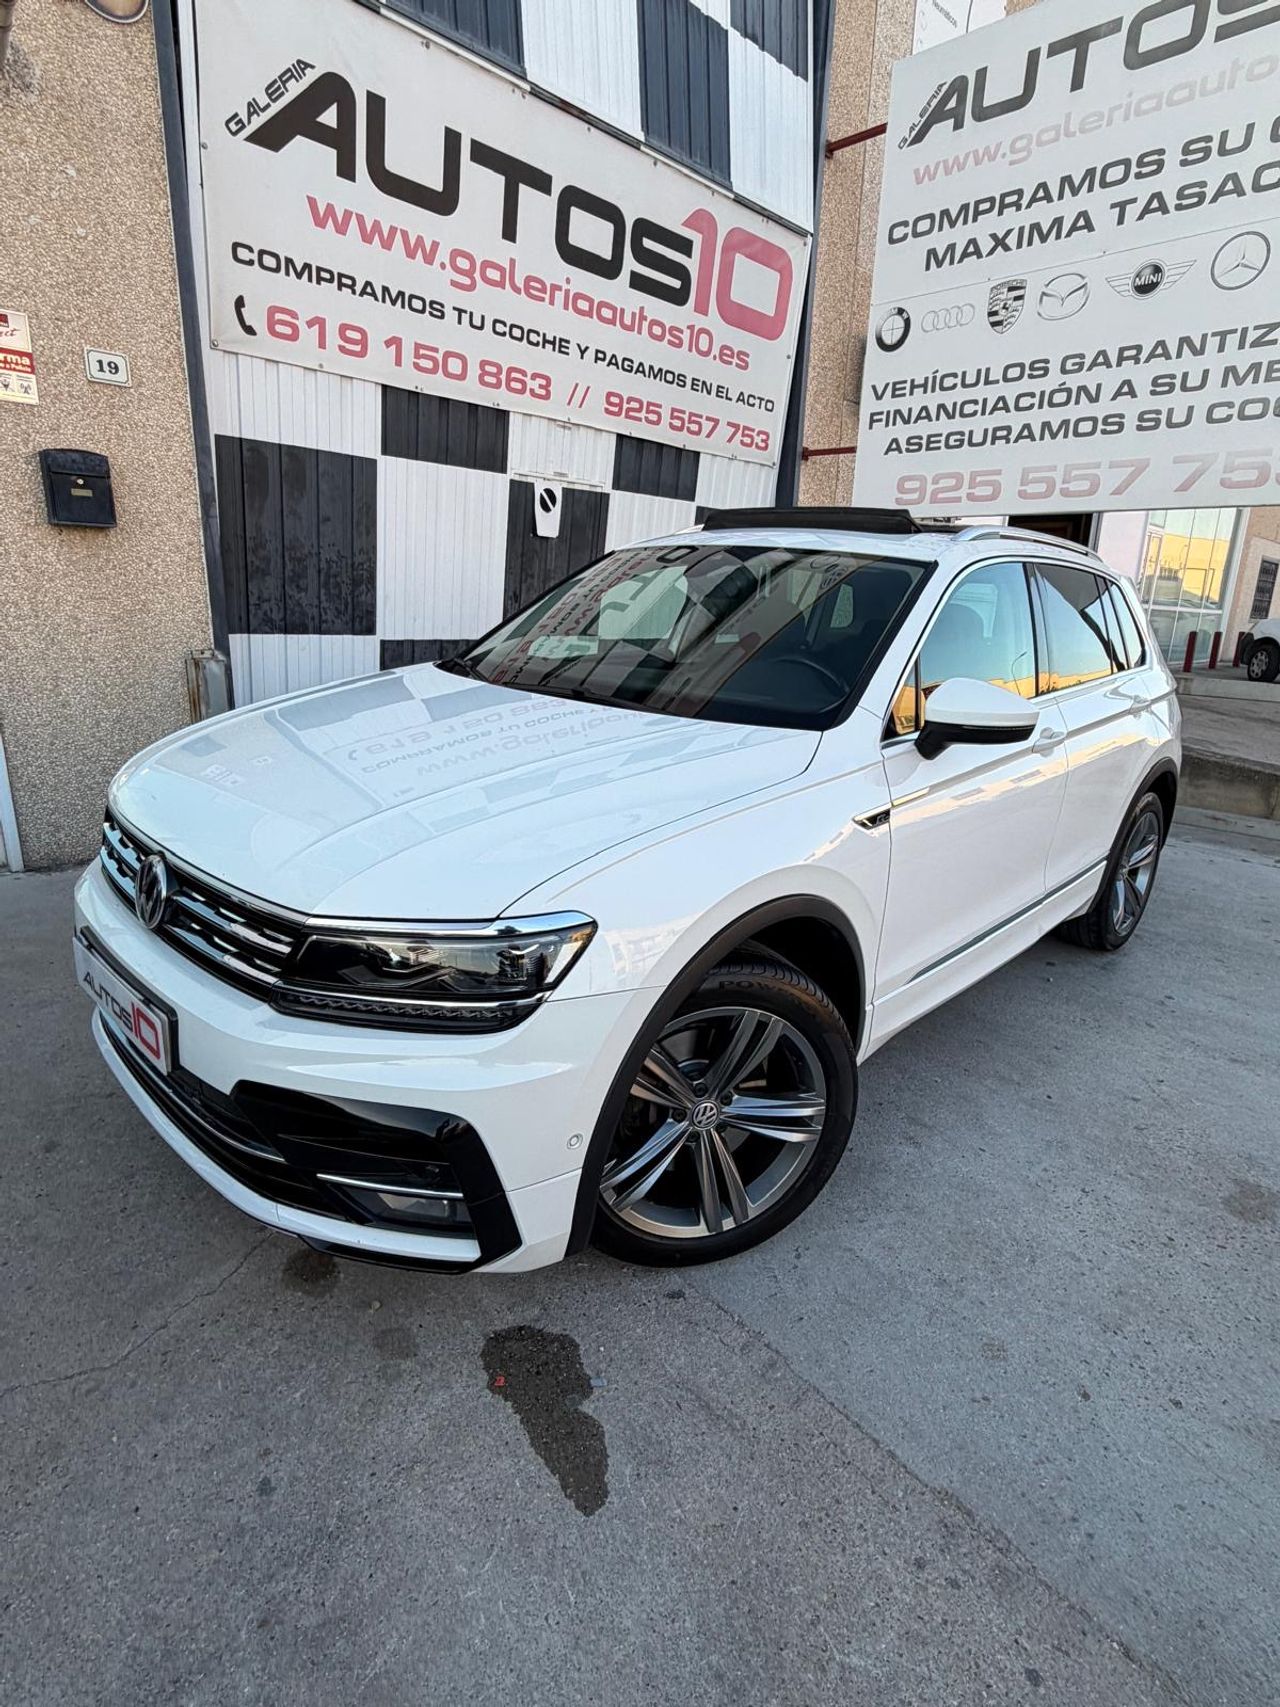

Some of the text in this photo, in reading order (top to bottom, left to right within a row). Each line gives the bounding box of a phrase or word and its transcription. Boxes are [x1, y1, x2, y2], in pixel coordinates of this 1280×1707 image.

[224, 58, 317, 137] GALERIA
[887, 147, 1166, 246] COMPRAMOS
[1178, 121, 1256, 168] SU
[924, 209, 1096, 272] MAXIMA
[306, 195, 751, 371] www.galeriaautos10.es
[1134, 272, 1162, 287] MINI
[231, 241, 775, 413] COMPRAMOS TU COCHE Y PAGAMOS EN EL ACTO
[871, 320, 1280, 402] VEHÍCULOS GARANTIZ
[96, 358, 121, 376] 19
[265, 304, 369, 360] 619
[383, 335, 468, 381] 150
[477, 360, 553, 402] 863
[604, 391, 664, 427] 925
[668, 409, 721, 441] 557
[725, 422, 771, 453] 753
[867, 381, 1103, 431] FINANCIACIÓN
[1109, 378, 1139, 402] A
[1148, 367, 1211, 398] SU
[883, 395, 1280, 456] ASEGURAMOS SU CO
[893, 448, 1280, 507] 925 557 75
